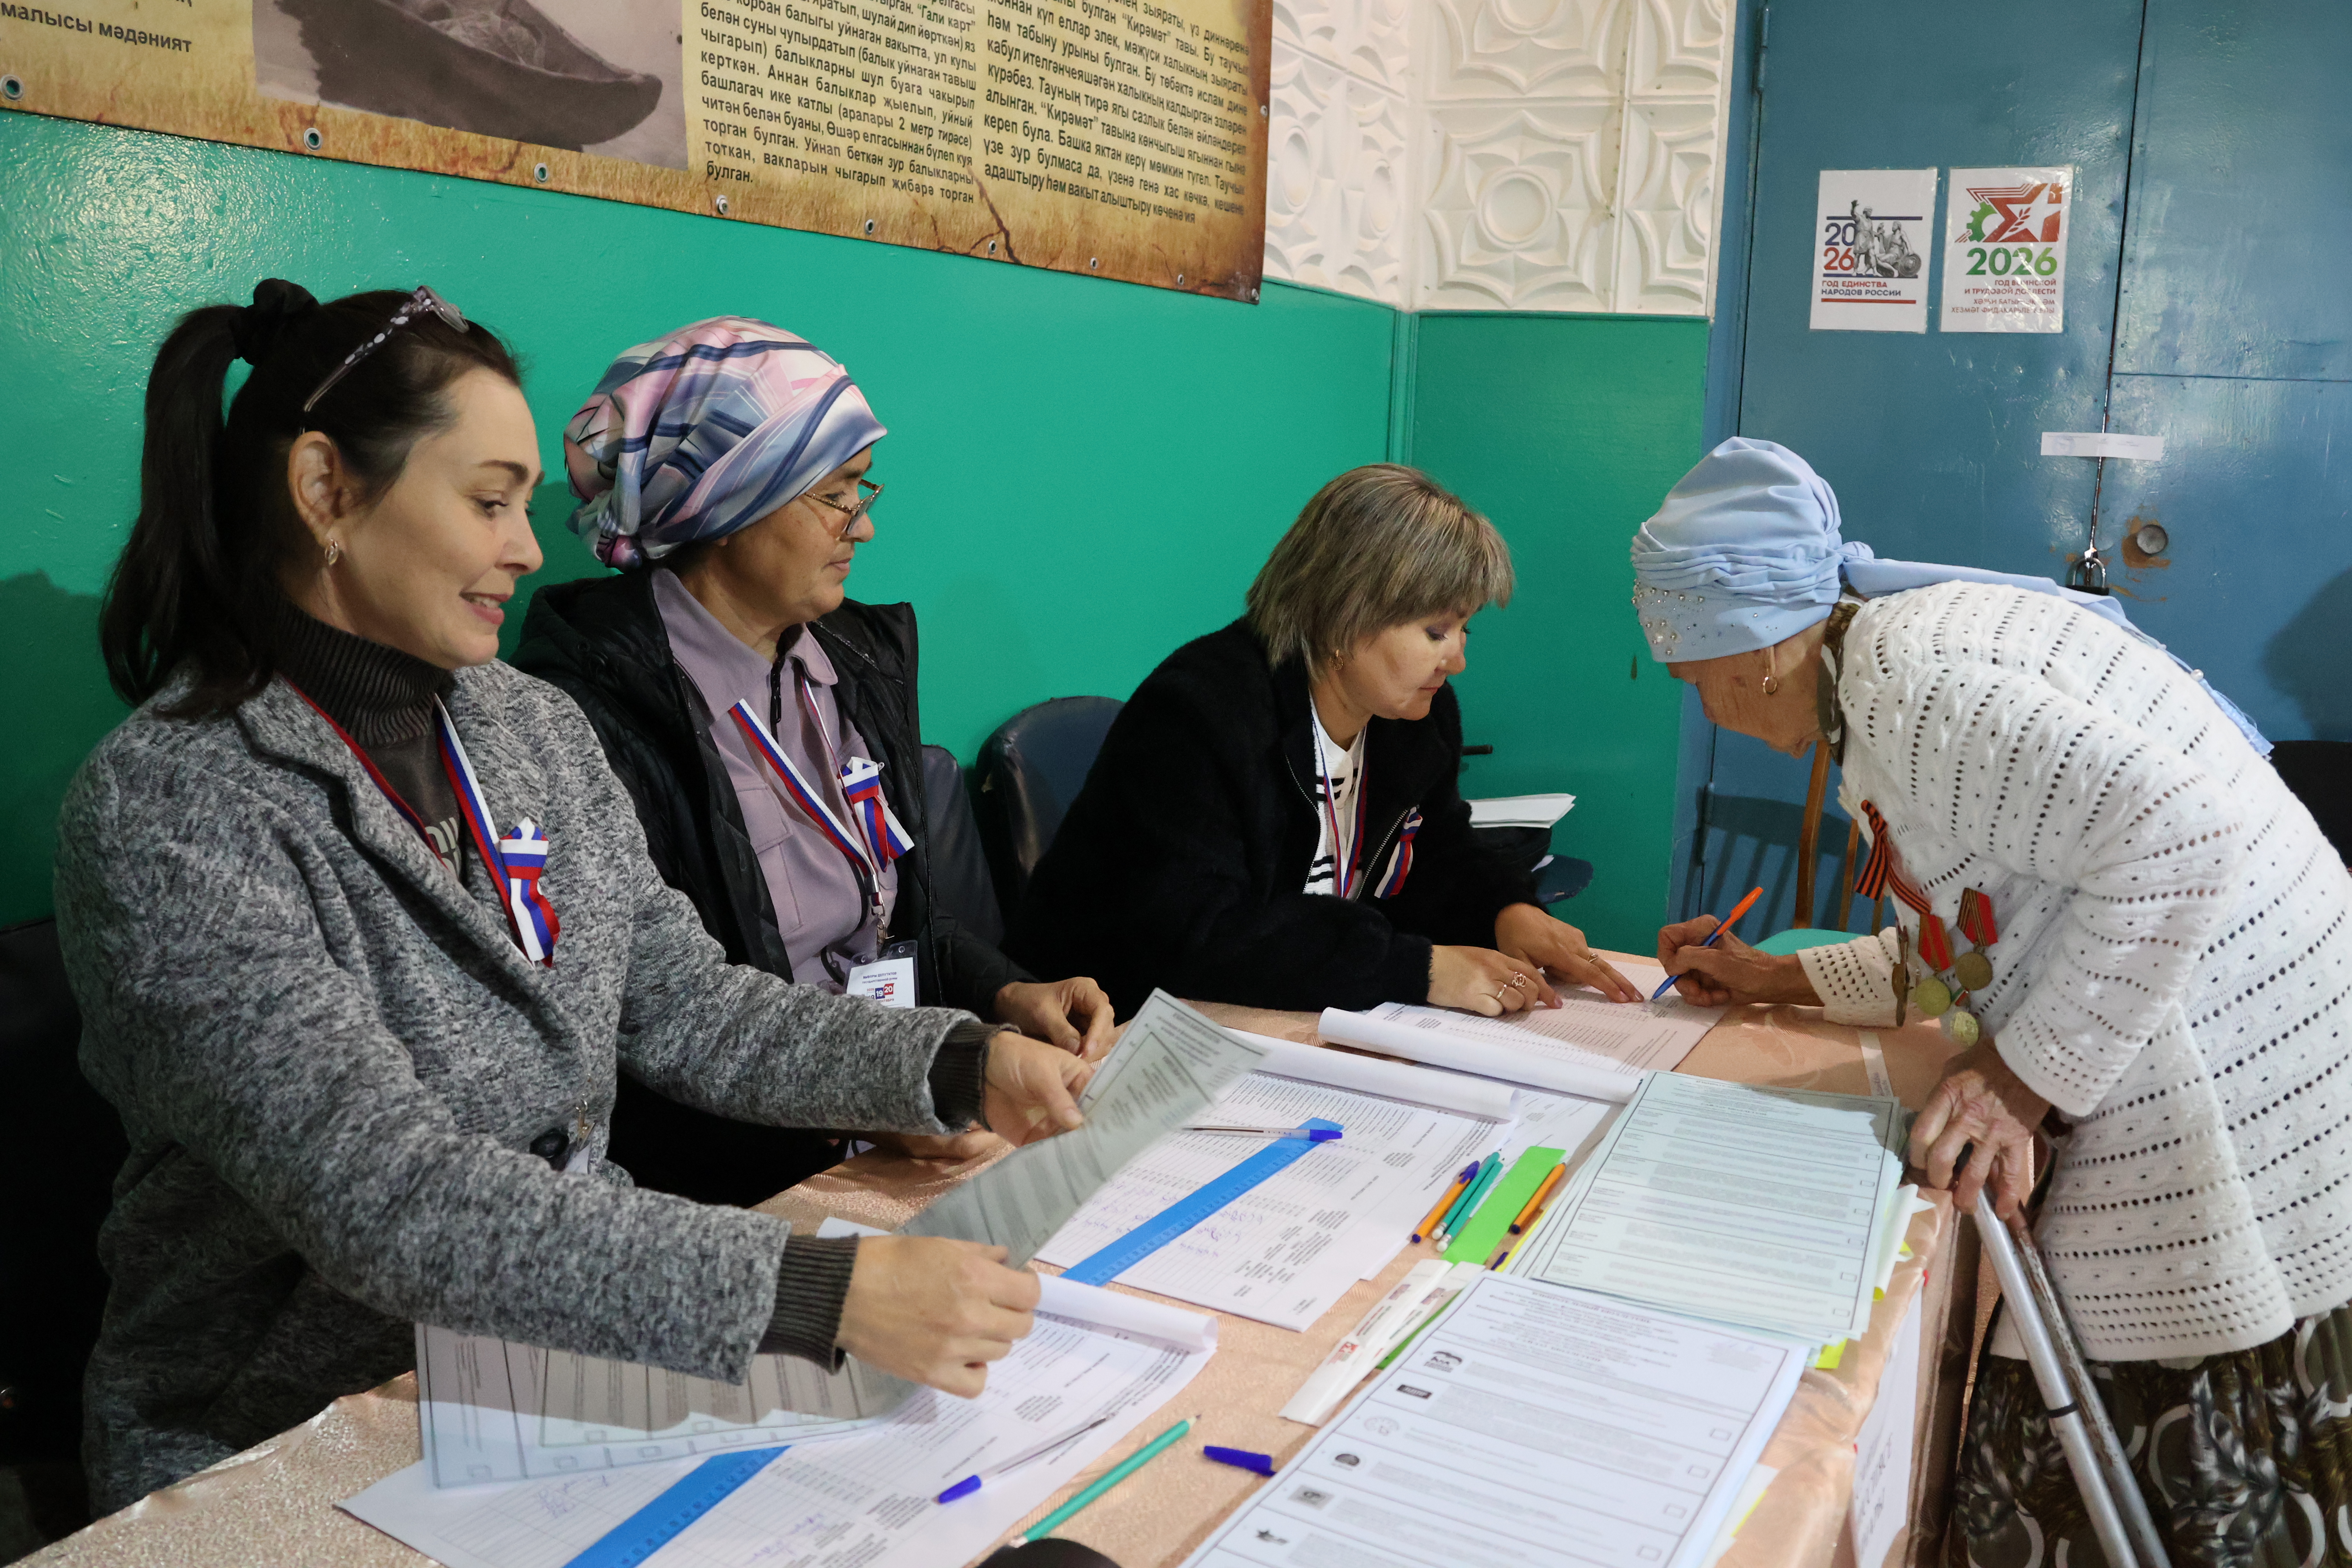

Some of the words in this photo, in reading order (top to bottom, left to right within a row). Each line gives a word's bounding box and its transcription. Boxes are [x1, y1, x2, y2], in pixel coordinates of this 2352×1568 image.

[1, 2, 93, 33] малысы
[99, 22, 192, 53] мәдәният
[701, 2, 739, 26] белән
[744, 17, 776, 36] суны
[780, 27, 855, 58] чупырдатып
[858, 46, 895, 69] (балык
[897, 60, 940, 81] уйнаган
[943, 72, 976, 91] тавыш
[786, 4, 833, 30] балыгы
[838, 21, 881, 45] уйнаган
[886, 37, 930, 61] вакытта,
[934, 51, 946, 64] ул
[951, 56, 976, 71] кулы
[862, 9, 896, 29] шулай
[897, 21, 916, 35] дип
[918, 25, 963, 52] йөрткән)
[965, 41, 975, 52] яз
[1037, 7, 1054, 25] күп
[1059, 15, 1090, 40] еллар
[1094, 29, 1120, 51] элек,
[1124, 40, 1160, 63] мәҗүси
[1163, 54, 1208, 84] халыкның
[1082, 0, 1116, 24] булган
[1204, 46, 1214, 66] Бу
[1143, 2, 1185, 33] зыяраты,
[1190, 23, 1200, 37] үз
[701, 27, 767, 59] чыгарып)
[775, 45, 855, 78] балыкларны
[862, 71, 884, 87] шул
[891, 76, 922, 96] буага
[929, 88, 975, 110] чакырып
[701, 51, 760, 76] керткән.
[768, 64, 809, 87] Аннан
[816, 76, 876, 107] балыклар
[884, 97, 936, 121] җыелып,
[942, 110, 973, 129] уйный
[987, 9, 1010, 33] һәм
[1016, 23, 1057, 53] табыну
[1062, 40, 1099, 64] урыны
[1104, 52, 1140, 78] булган.
[1145, 65, 1156, 87] Бу
[1160, 74, 1194, 97] төбәктә
[1197, 89, 1224, 107] ислам
[987, 38, 1020, 62] кабул
[1117, 82, 1164, 111] халыкның
[1166, 99, 1212, 125] калдырган
[701, 70, 764, 98] башлагач
[770, 90, 791, 105] ике
[798, 96, 833, 114] катлы
[838, 103, 893, 128] (аралары
[899, 116, 905, 131] 2
[911, 122, 933, 140] метр
[938, 129, 971, 150] тирәсе)
[702, 96, 740, 115] читән
[743, 102, 781, 123] белән
[784, 111, 824, 136] буаны,
[827, 121, 860, 143] Өшәр
[863, 131, 924, 155] елгасыннан
[926, 143, 954, 162] бүлеп
[957, 154, 973, 168] куя
[985, 88, 1037, 116] алынган.
[1101, 121, 1136, 143] тавына
[1138, 133, 1185, 158] көнчыгыш
[988, 63, 1034, 90] күрәбез.
[1038, 76, 1081, 107] Тауның
[1084, 93, 1109, 113] тирә
[1112, 103, 1129, 119] ягы
[1132, 109, 1165, 131] сазлык
[1167, 118, 1194, 140] белән
[703, 118, 747, 138] торган
[754, 125, 799, 149] булган.
[804, 136, 841, 157] Уйнап
[847, 145, 883, 166] беткән
[888, 157, 904, 173] зур
[909, 159, 974, 185] балыкларны
[705, 141, 755, 164] тоткан,
[764, 152, 827, 175] вакларын
[835, 166, 885, 187] чыгарып
[892, 178, 934, 197] җибәрә
[940, 187, 973, 203] торган
[706, 160, 753, 183] булган.
[983, 138, 1004, 156] үзе
[1011, 145, 1031, 164] зур
[1037, 147, 1082, 174] булмаса
[1087, 164, 1102, 181] да,
[1108, 169, 1134, 187] үзенә
[1139, 178, 1159, 194] генә
[1164, 185, 1179, 199] хас
[984, 114, 1018, 134] кереп
[1023, 120, 1054, 143] була.
[1058, 129, 1091, 154] Башка
[1095, 143, 1122, 162] яктан
[1125, 152, 1147, 172] керү
[1149, 159, 1184, 179] мөмкин
[985, 163, 1045, 192] адаштыру
[1046, 174, 1066, 193] һәм
[1068, 182, 1099, 201] вакыт
[1100, 190, 1152, 216] алыштыру
[1824, 247, 1854, 270] 26
[1825, 223, 1856, 246] 20
[1965, 247, 2057, 276] 2026
